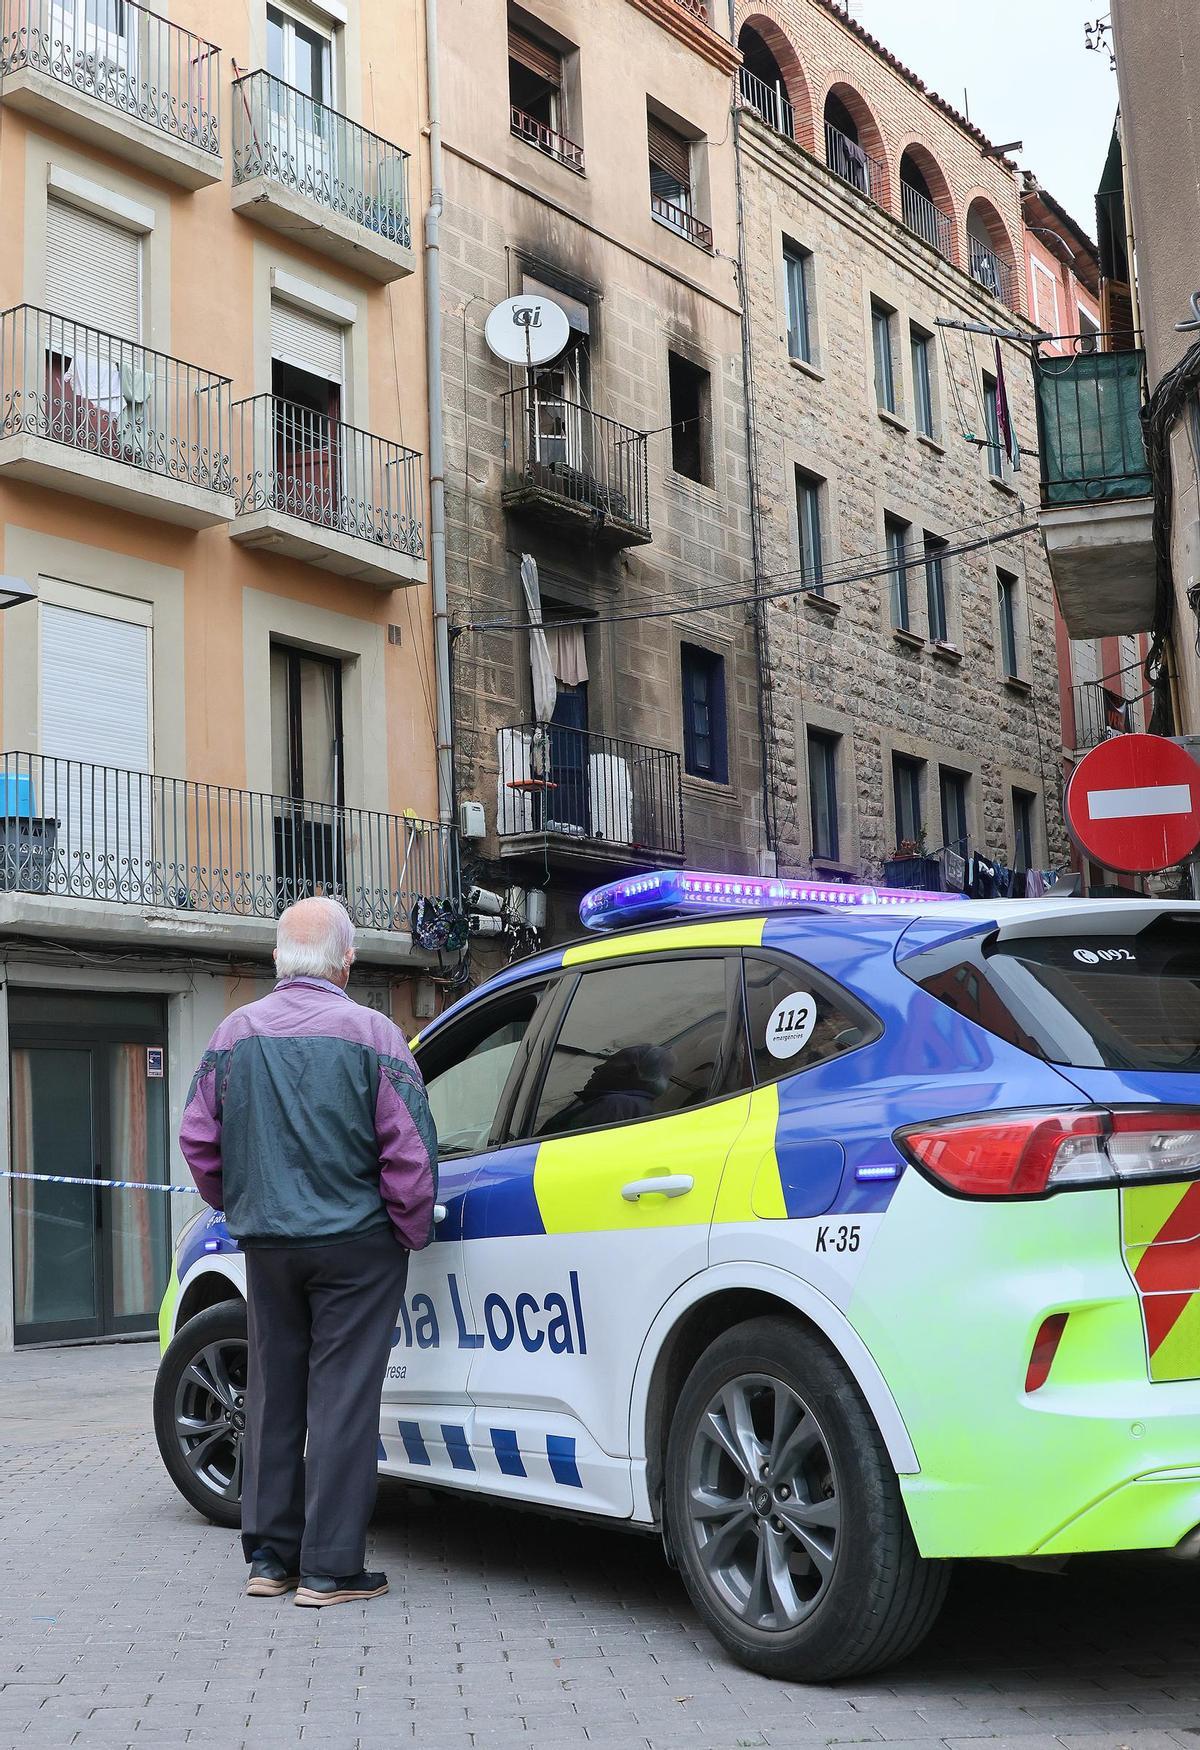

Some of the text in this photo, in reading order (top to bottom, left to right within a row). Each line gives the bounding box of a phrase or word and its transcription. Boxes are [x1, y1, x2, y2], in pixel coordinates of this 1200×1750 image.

[1097, 949, 1136, 961] 092
[775, 1008, 808, 1032] 112
[815, 1225, 861, 1252] K-35
[447, 1271, 588, 1355] Local
[386, 1365, 407, 1379] resa
